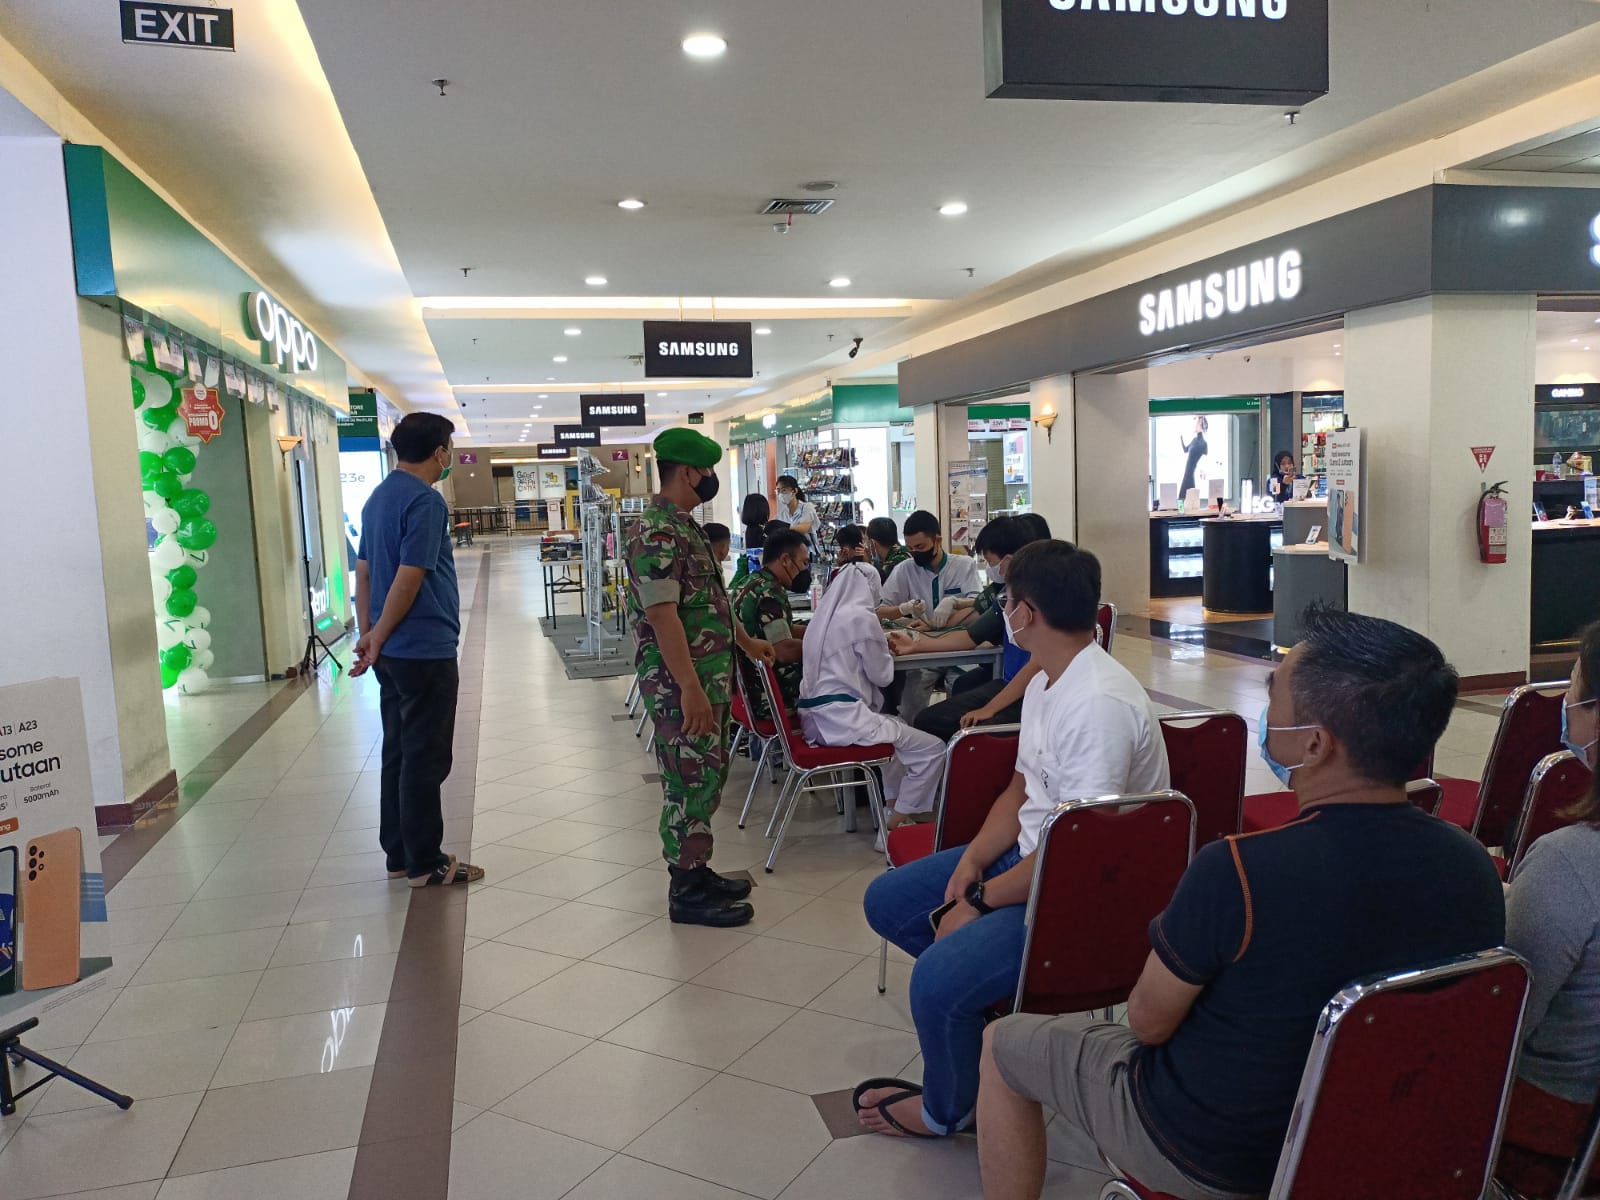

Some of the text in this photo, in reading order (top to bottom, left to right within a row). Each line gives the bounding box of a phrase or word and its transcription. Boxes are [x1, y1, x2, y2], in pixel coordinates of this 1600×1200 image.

[134, 8, 219, 44] EXIT
[1138, 249, 1302, 336] SAMSUNG
[255, 291, 318, 374] oppo
[658, 341, 739, 357] SAMSUNG
[588, 405, 638, 416] SAMSUNG
[559, 432, 596, 440] SAMSUNG
[465, 454, 472, 462] 2
[617, 451, 623, 459] 2
[19, 720, 38, 732] A23
[0, 741, 43, 760] some
[0, 756, 61, 783] utaan
[24, 789, 59, 804] 5000mAh
